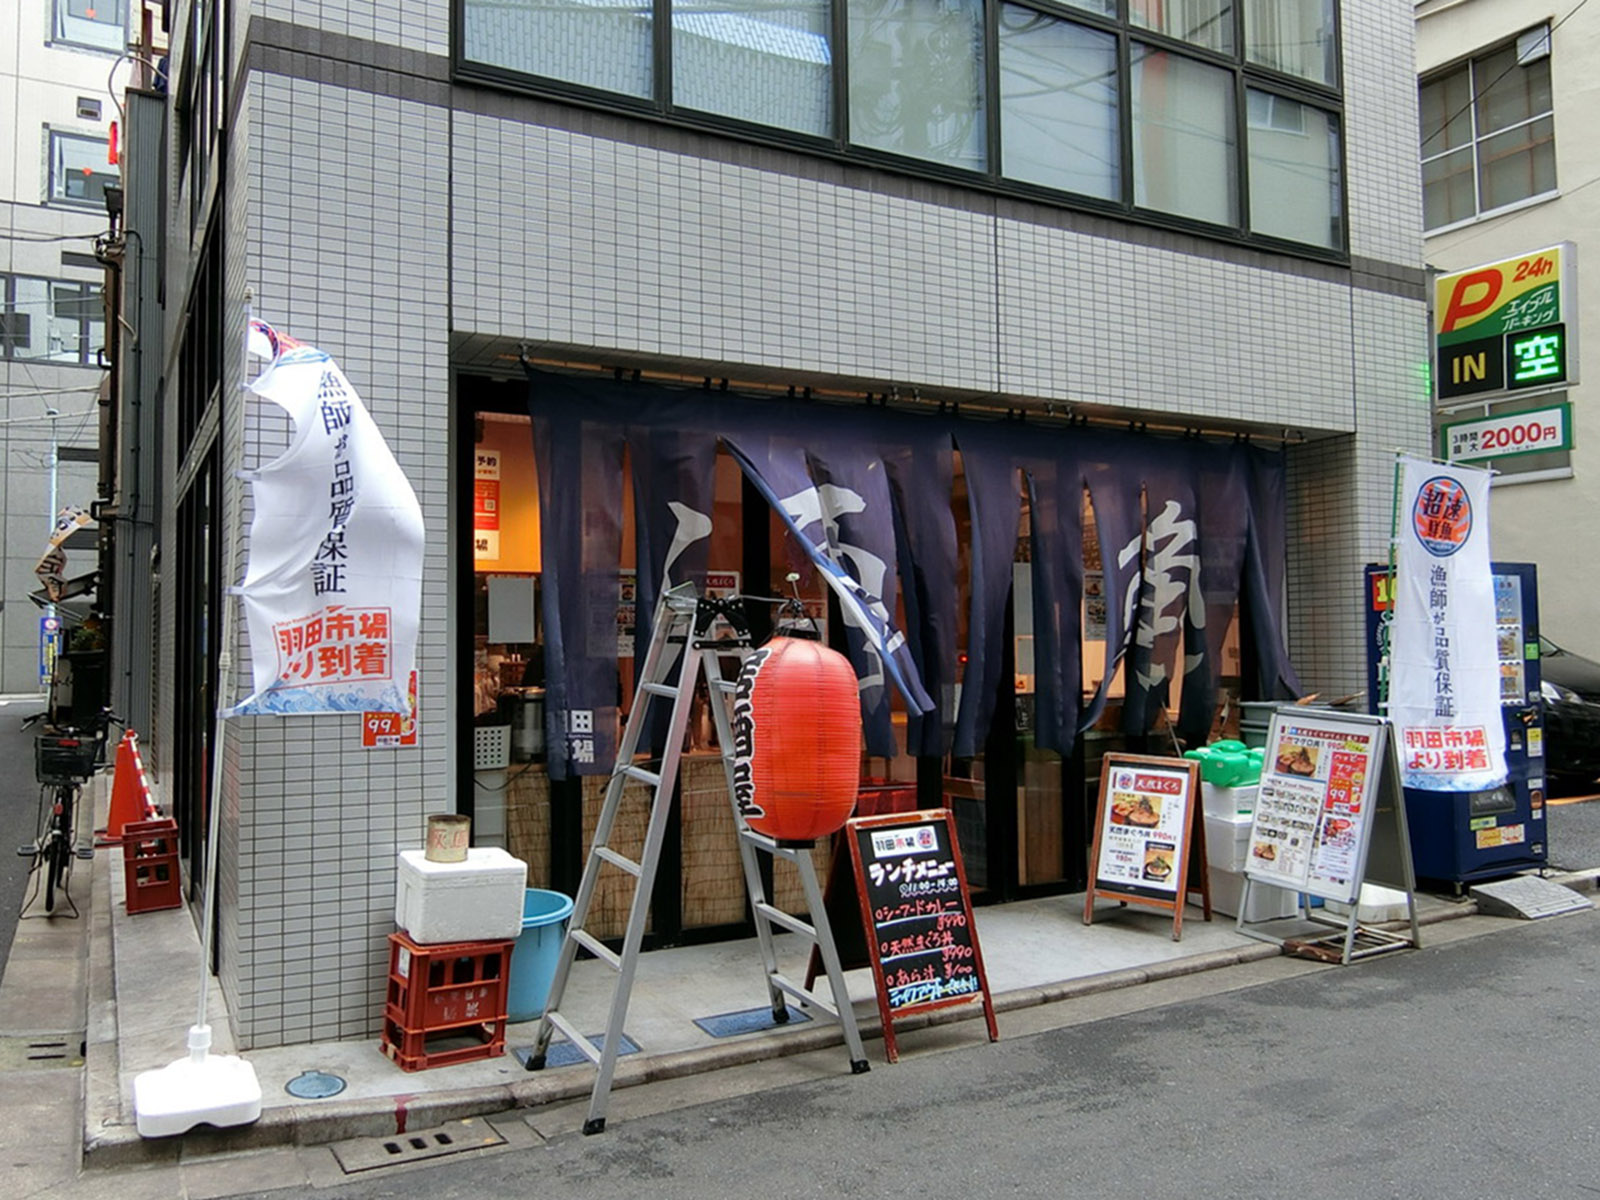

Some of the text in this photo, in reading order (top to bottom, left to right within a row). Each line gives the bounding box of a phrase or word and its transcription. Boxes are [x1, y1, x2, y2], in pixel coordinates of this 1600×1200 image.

[1512, 257, 1553, 283] 24h
[1440, 268, 1503, 333] P
[1453, 352, 1486, 384] IN
[1515, 335, 1559, 380] 空
[1481, 423, 1557, 450] 2000円
[279, 612, 387, 657] 羽田市場
[1429, 564, 1455, 719] 漁師が品質保証
[282, 642, 387, 680] り到着
[1405, 729, 1485, 749] 羽田市場
[1403, 748, 1487, 770] より到着
[868, 857, 955, 887] ランチメニュー
